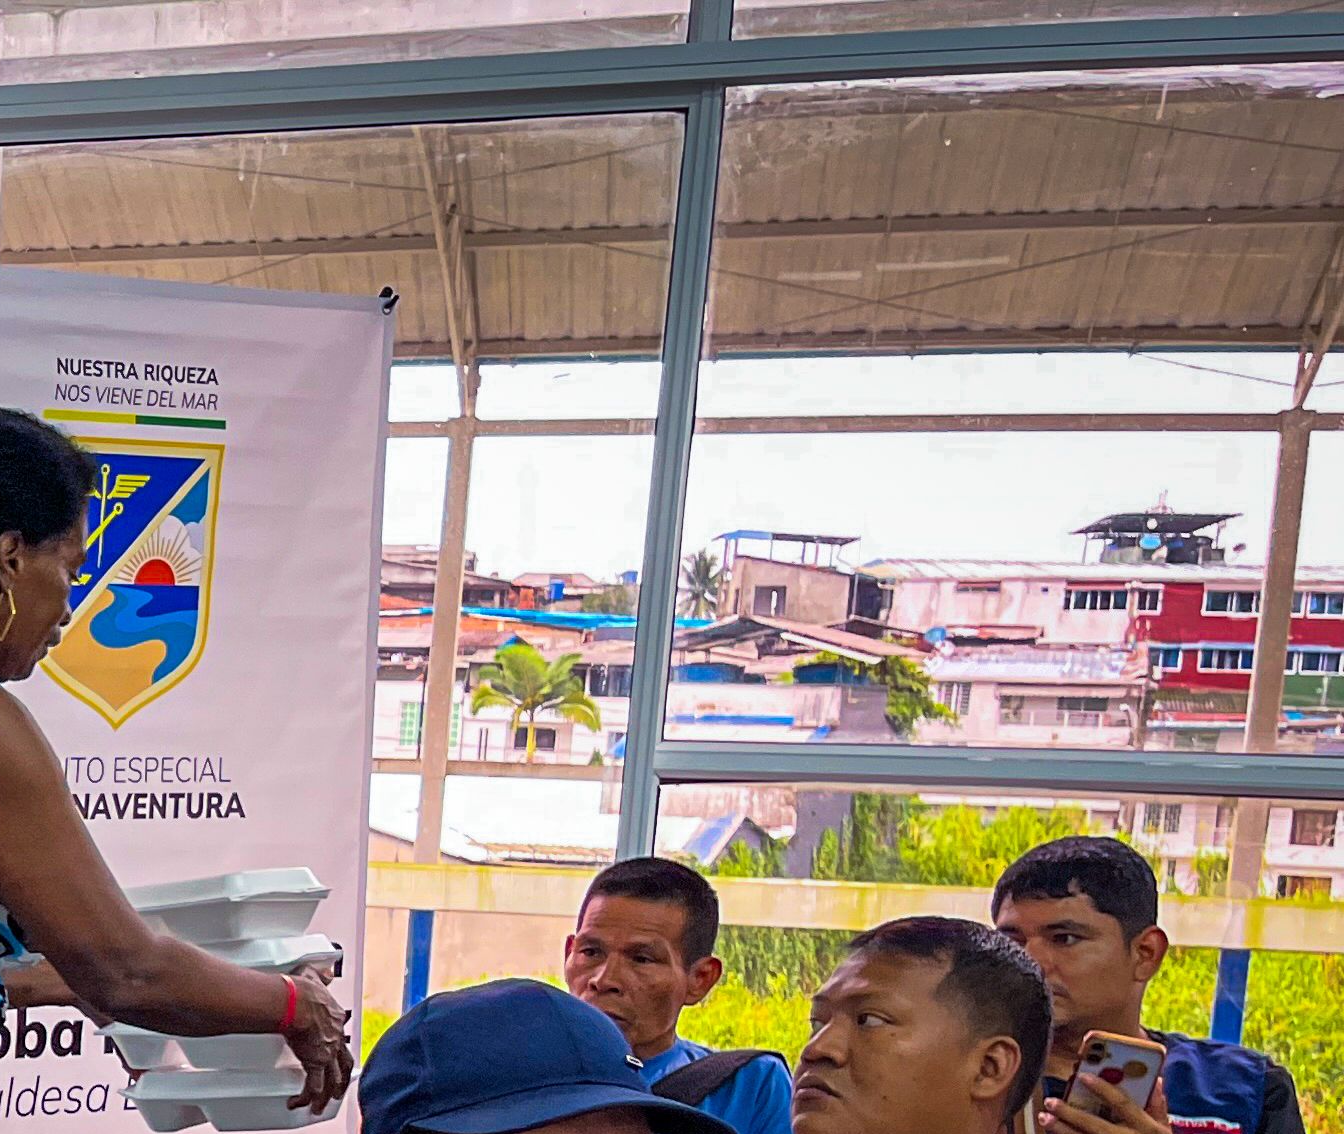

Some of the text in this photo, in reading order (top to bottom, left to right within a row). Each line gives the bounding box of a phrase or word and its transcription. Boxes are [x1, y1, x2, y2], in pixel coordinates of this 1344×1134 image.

[56, 357, 219, 386] NUESTRA RIQUEZA
[55, 383, 219, 411] NOS VIENE DEL MAR
[64, 757, 232, 783] ITO ESPECIAL
[72, 792, 246, 820] NAVENTURA
